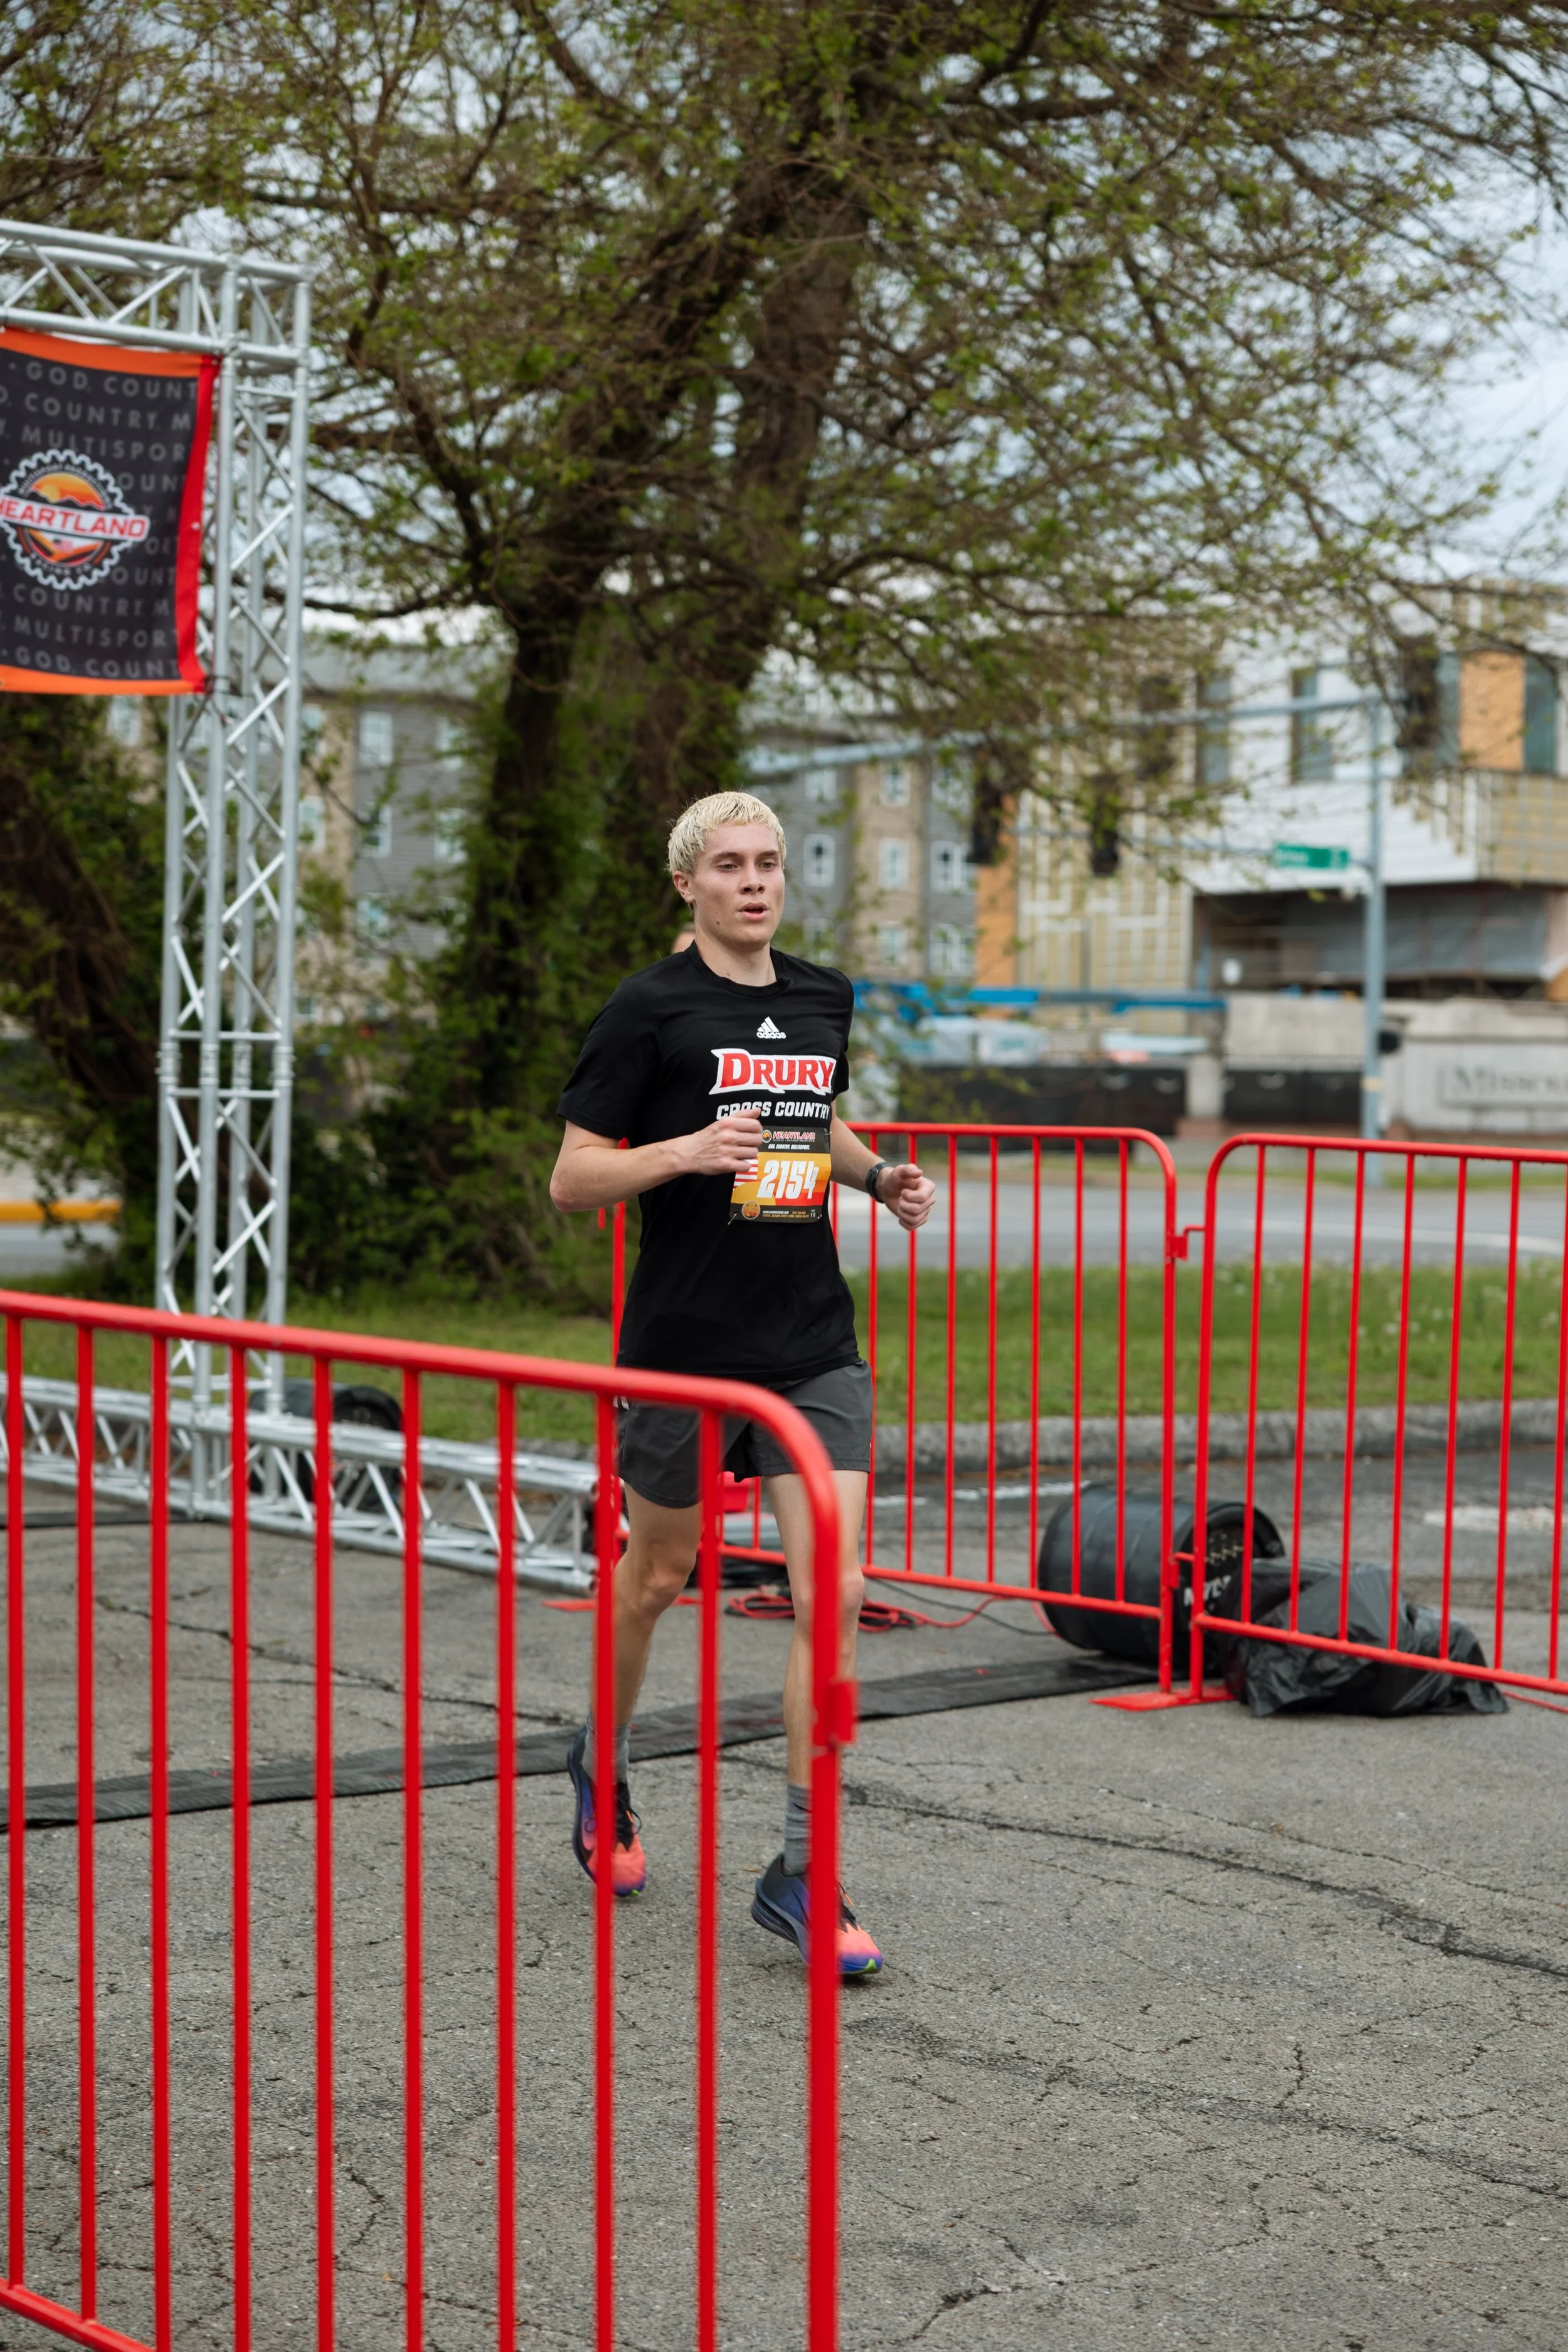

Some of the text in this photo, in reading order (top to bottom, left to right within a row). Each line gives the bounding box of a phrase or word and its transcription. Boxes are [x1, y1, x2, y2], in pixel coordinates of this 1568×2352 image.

[0, 496, 146, 538] EARTLAND
[14, 615, 176, 648] MULTISPOR
[756, 1031, 787, 1039] adidas
[719, 1052, 835, 1090] DRURY
[775, 1101, 830, 1120] COUNTRY
[772, 1131, 816, 1140] HEARTLAND
[756, 1160, 820, 1200] 2154
